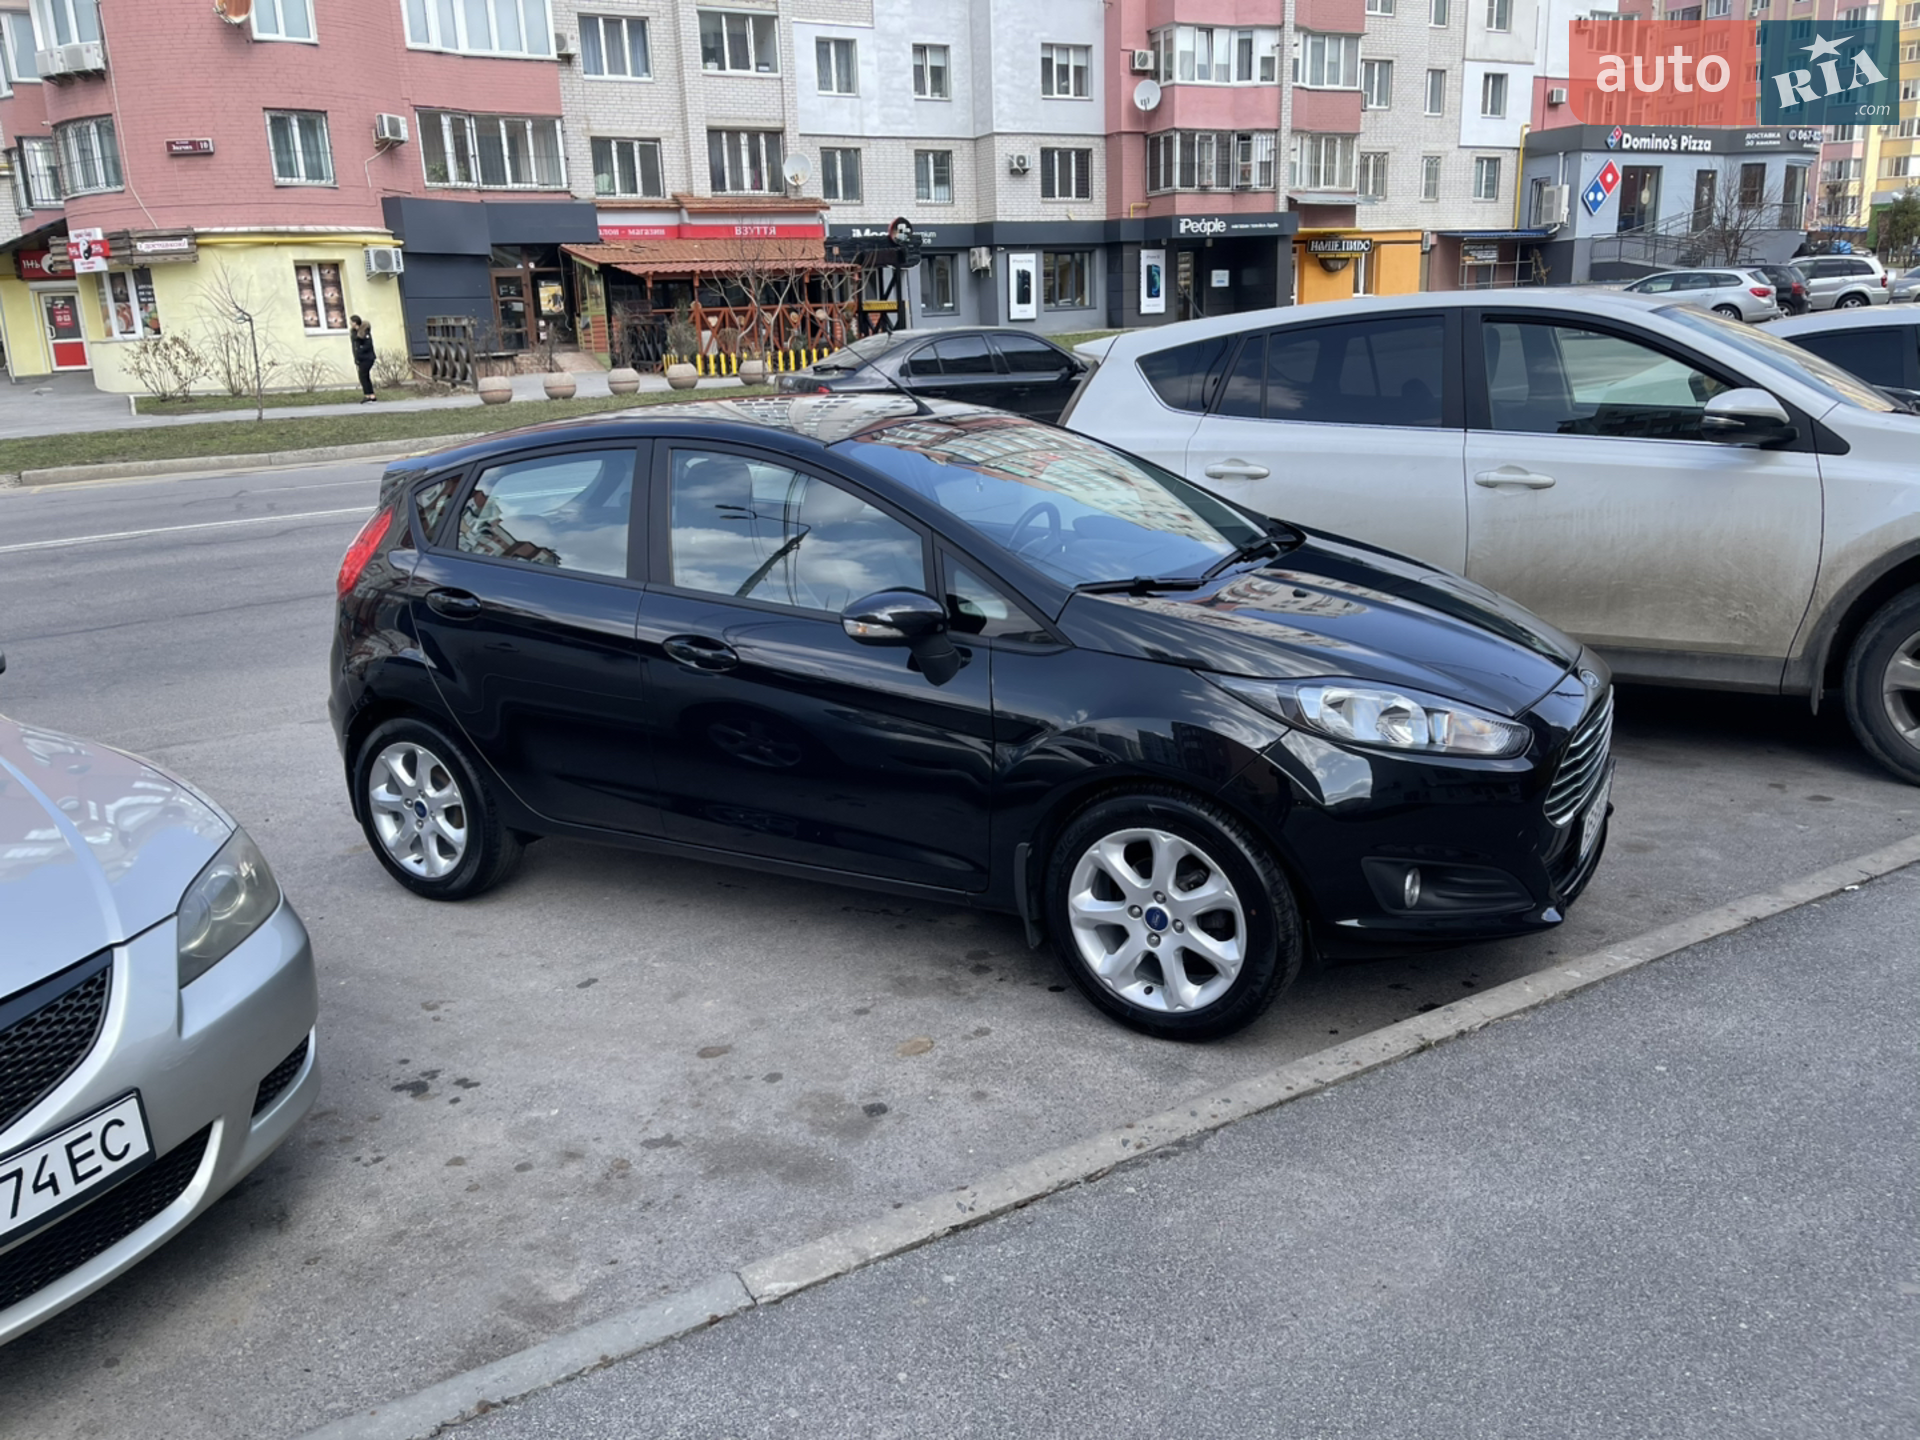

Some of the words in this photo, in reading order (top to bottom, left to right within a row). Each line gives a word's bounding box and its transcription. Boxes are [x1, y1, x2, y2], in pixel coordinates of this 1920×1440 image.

[1622, 132, 1678, 151] Domino's
[1680, 134, 1712, 151] Pizza
[1745, 132, 1781, 140] ДОСТАВКА
[734, 226, 777, 236] ВЗУТТЯ
[1180, 217, 1227, 236] iPeople
[1311, 240, 1341, 251] НАШЕ
[1342, 240, 1371, 251] ПИВО
